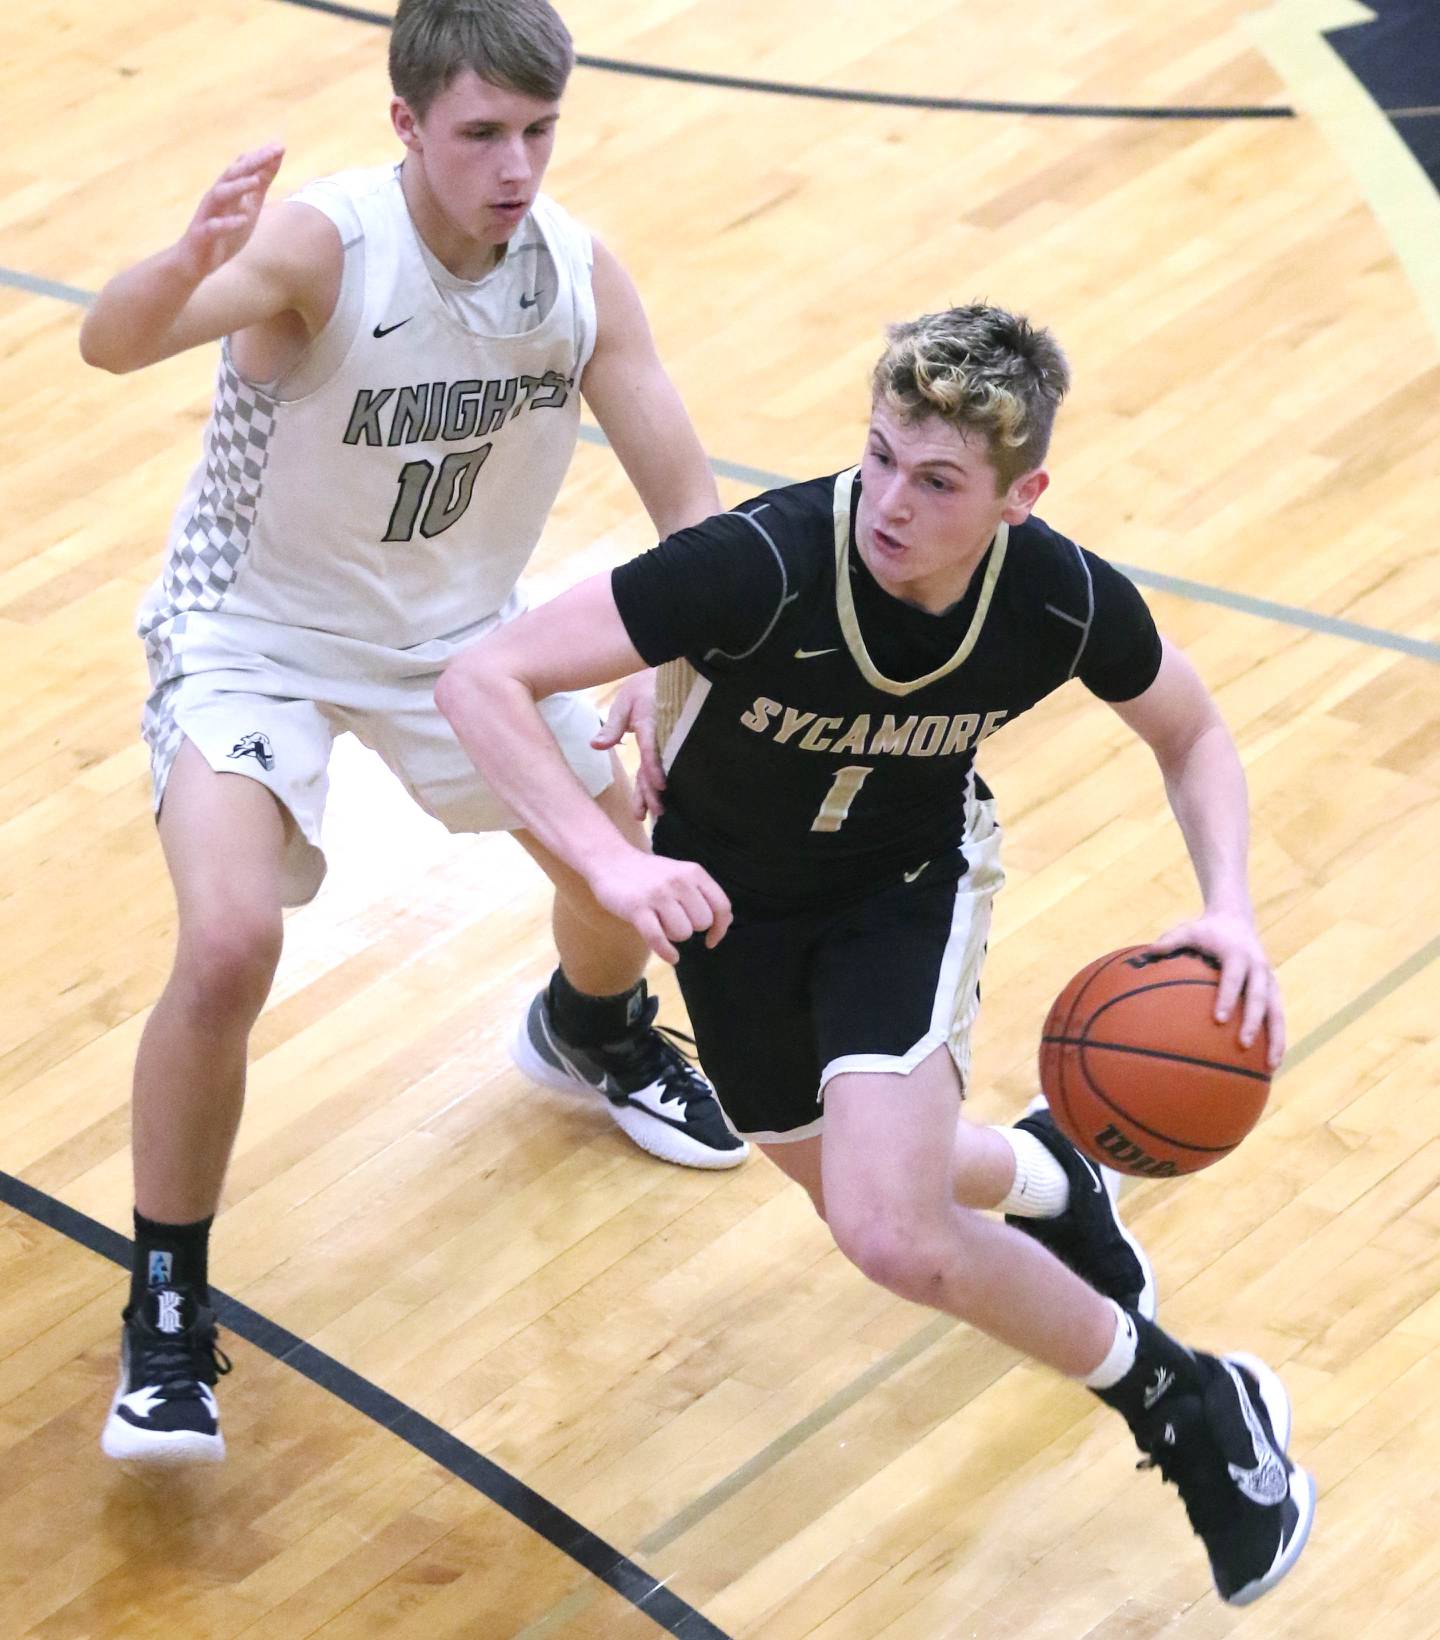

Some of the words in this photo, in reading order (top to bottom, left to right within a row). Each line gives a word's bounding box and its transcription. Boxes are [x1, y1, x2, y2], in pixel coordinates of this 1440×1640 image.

[342, 370, 568, 447] KNIGHTS
[381, 442, 493, 542] 10
[810, 765, 874, 832] 1
